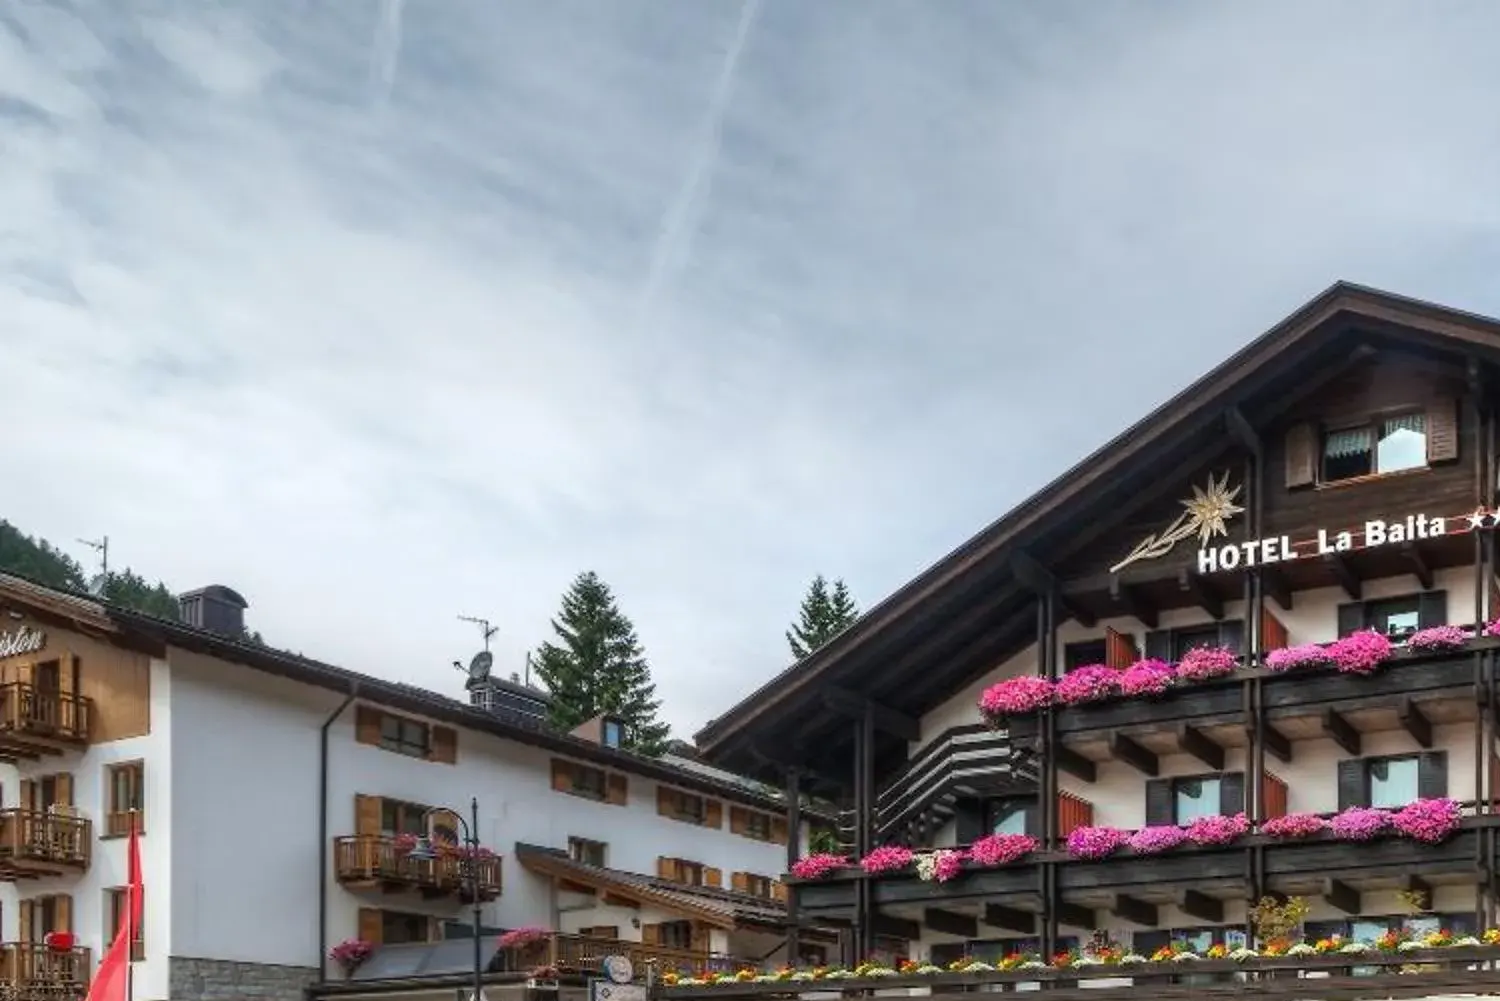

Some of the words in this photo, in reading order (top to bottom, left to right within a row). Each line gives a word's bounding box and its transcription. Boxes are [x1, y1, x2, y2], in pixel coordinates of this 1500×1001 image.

[1198, 535, 1298, 574] HOTEL
[1317, 529, 1351, 554] La
[1364, 513, 1446, 547] Baita
